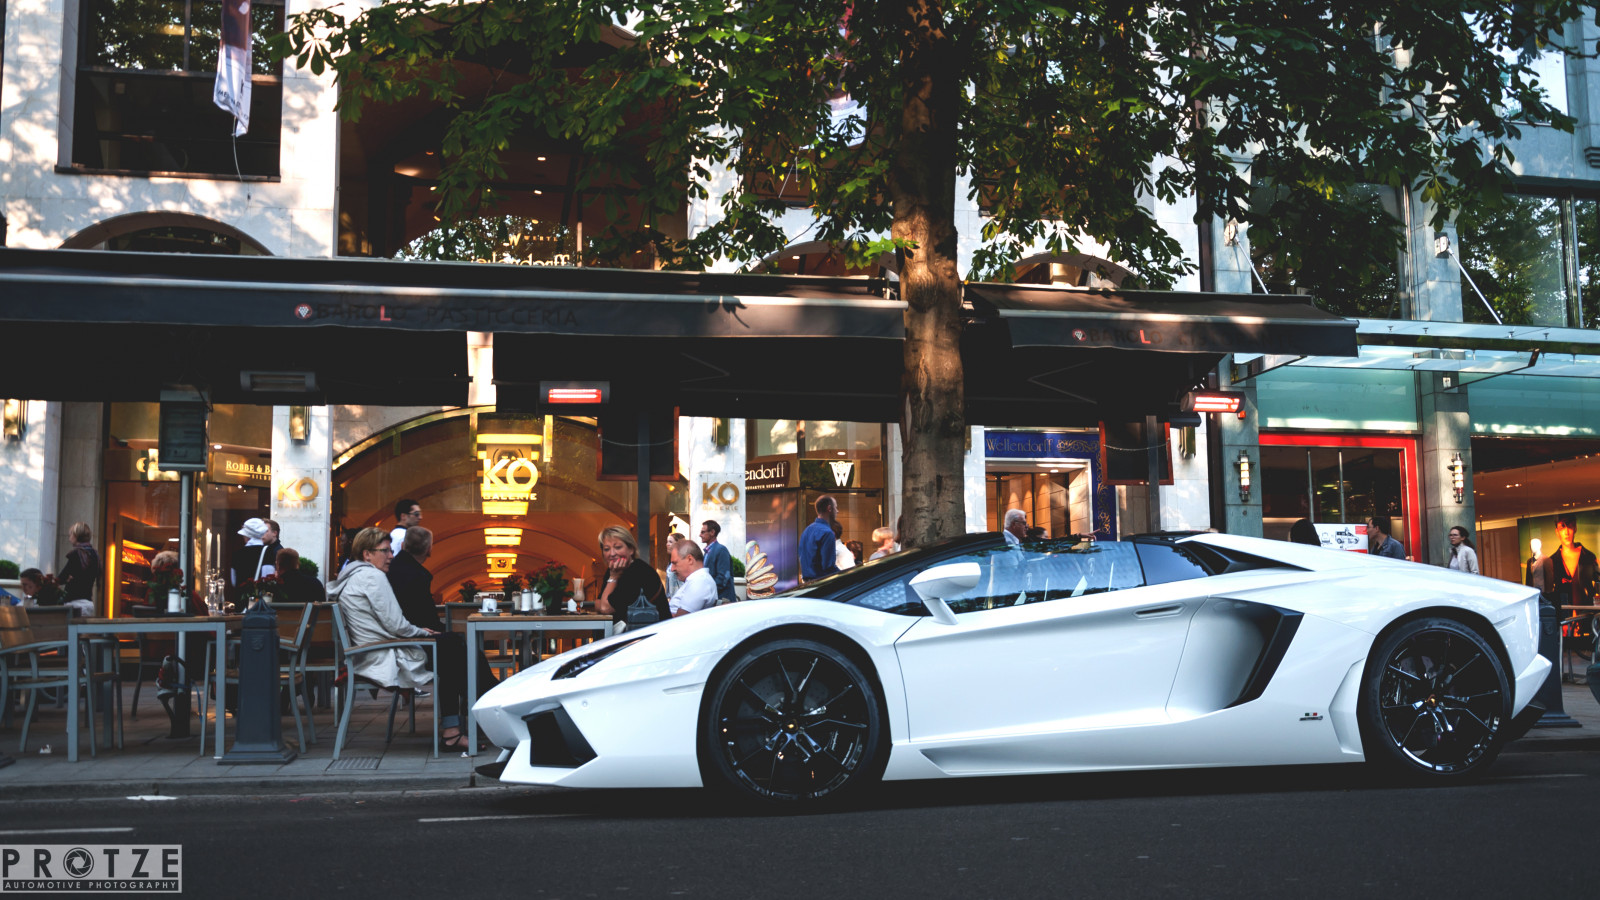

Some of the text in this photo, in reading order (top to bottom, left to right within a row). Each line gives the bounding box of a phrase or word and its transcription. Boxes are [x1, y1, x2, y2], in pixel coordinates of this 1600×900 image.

[317, 304, 579, 326] BAROLO PASTICCERIA
[1089, 327, 1163, 345] BAROLO
[986, 438, 1053, 452] Wellendorff
